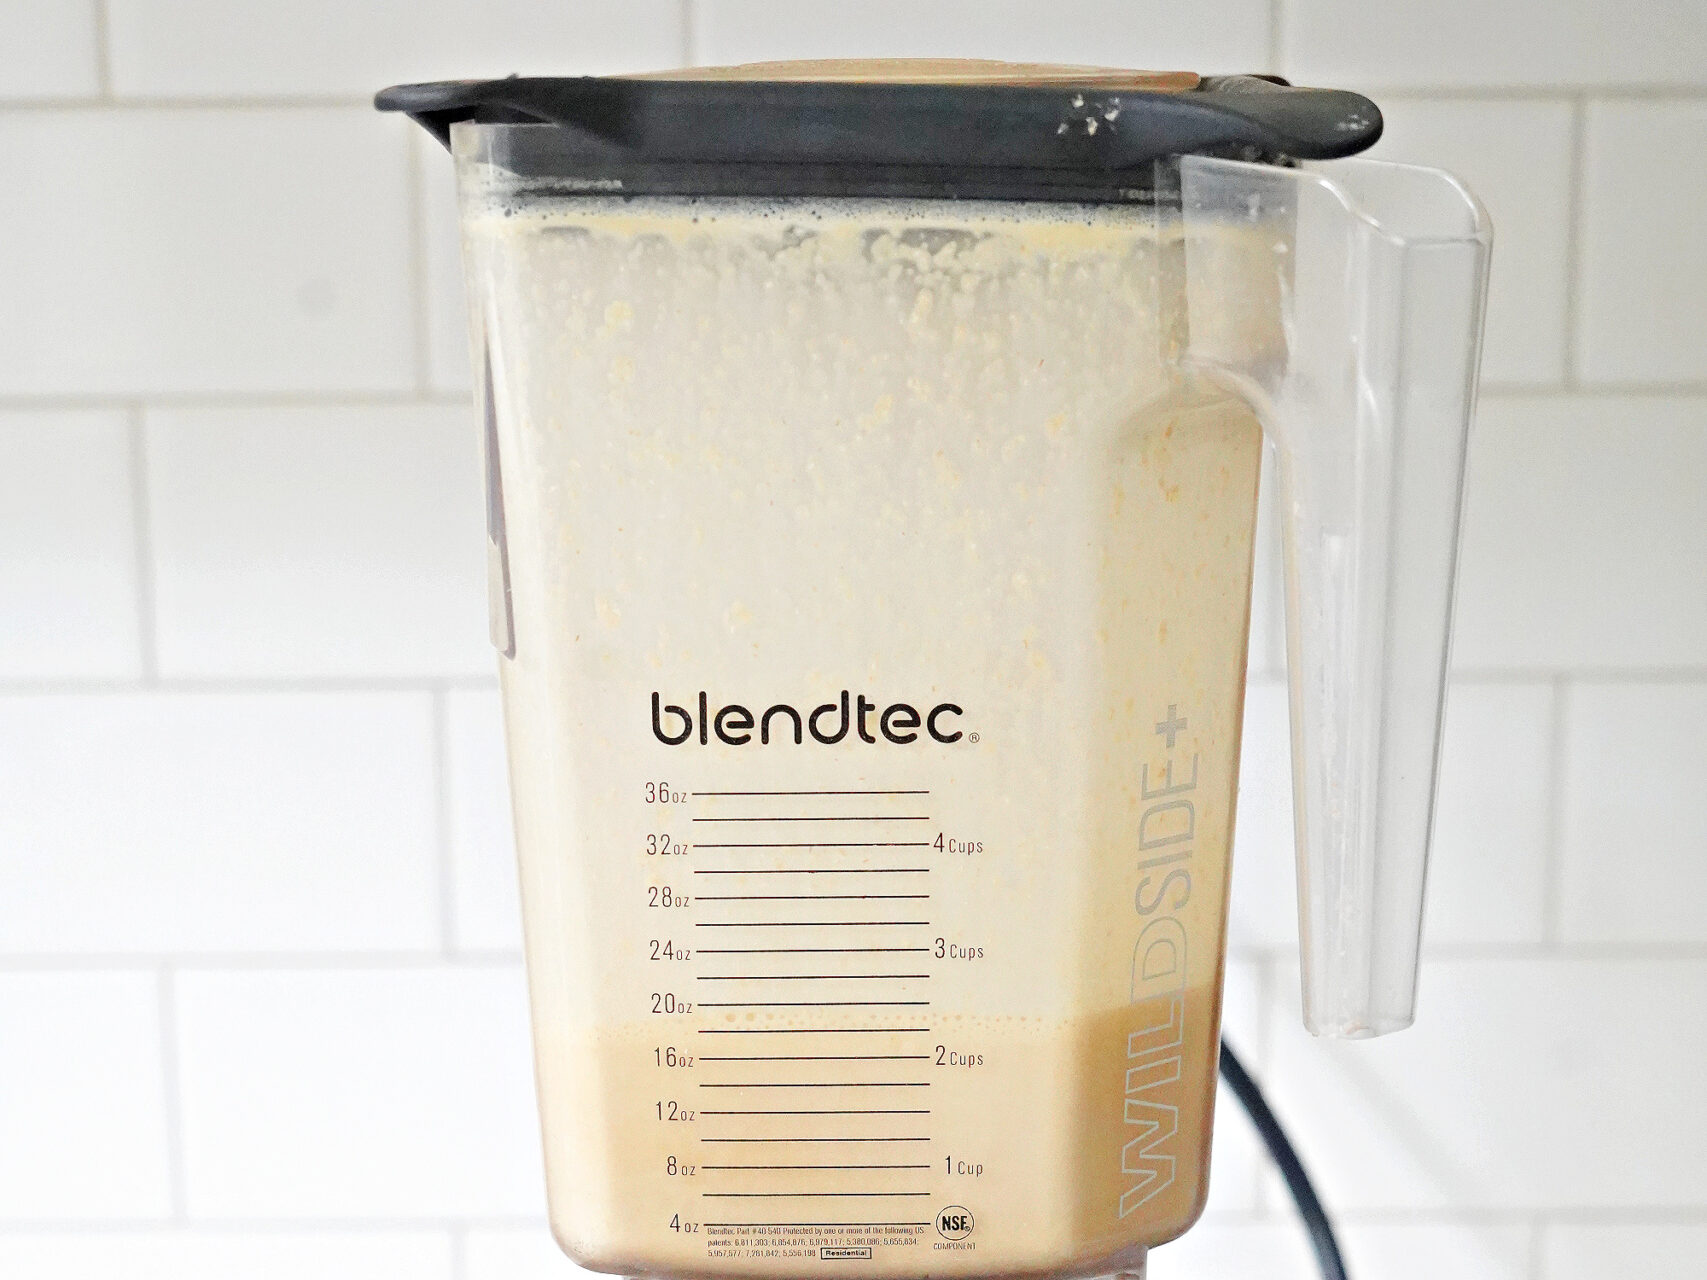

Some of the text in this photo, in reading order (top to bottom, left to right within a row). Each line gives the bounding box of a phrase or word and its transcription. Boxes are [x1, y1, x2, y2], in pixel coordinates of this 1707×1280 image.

[933, 832, 984, 856] 4 Cups
[934, 937, 984, 961] 3 Cups
[935, 1045, 984, 1068] 2 Cups
[944, 1155, 984, 1177] 1 Cup
[782, 1226, 814, 1235] Protected
[825, 1249, 868, 1257] Residential
[933, 1242, 976, 1250] COMPONENT
